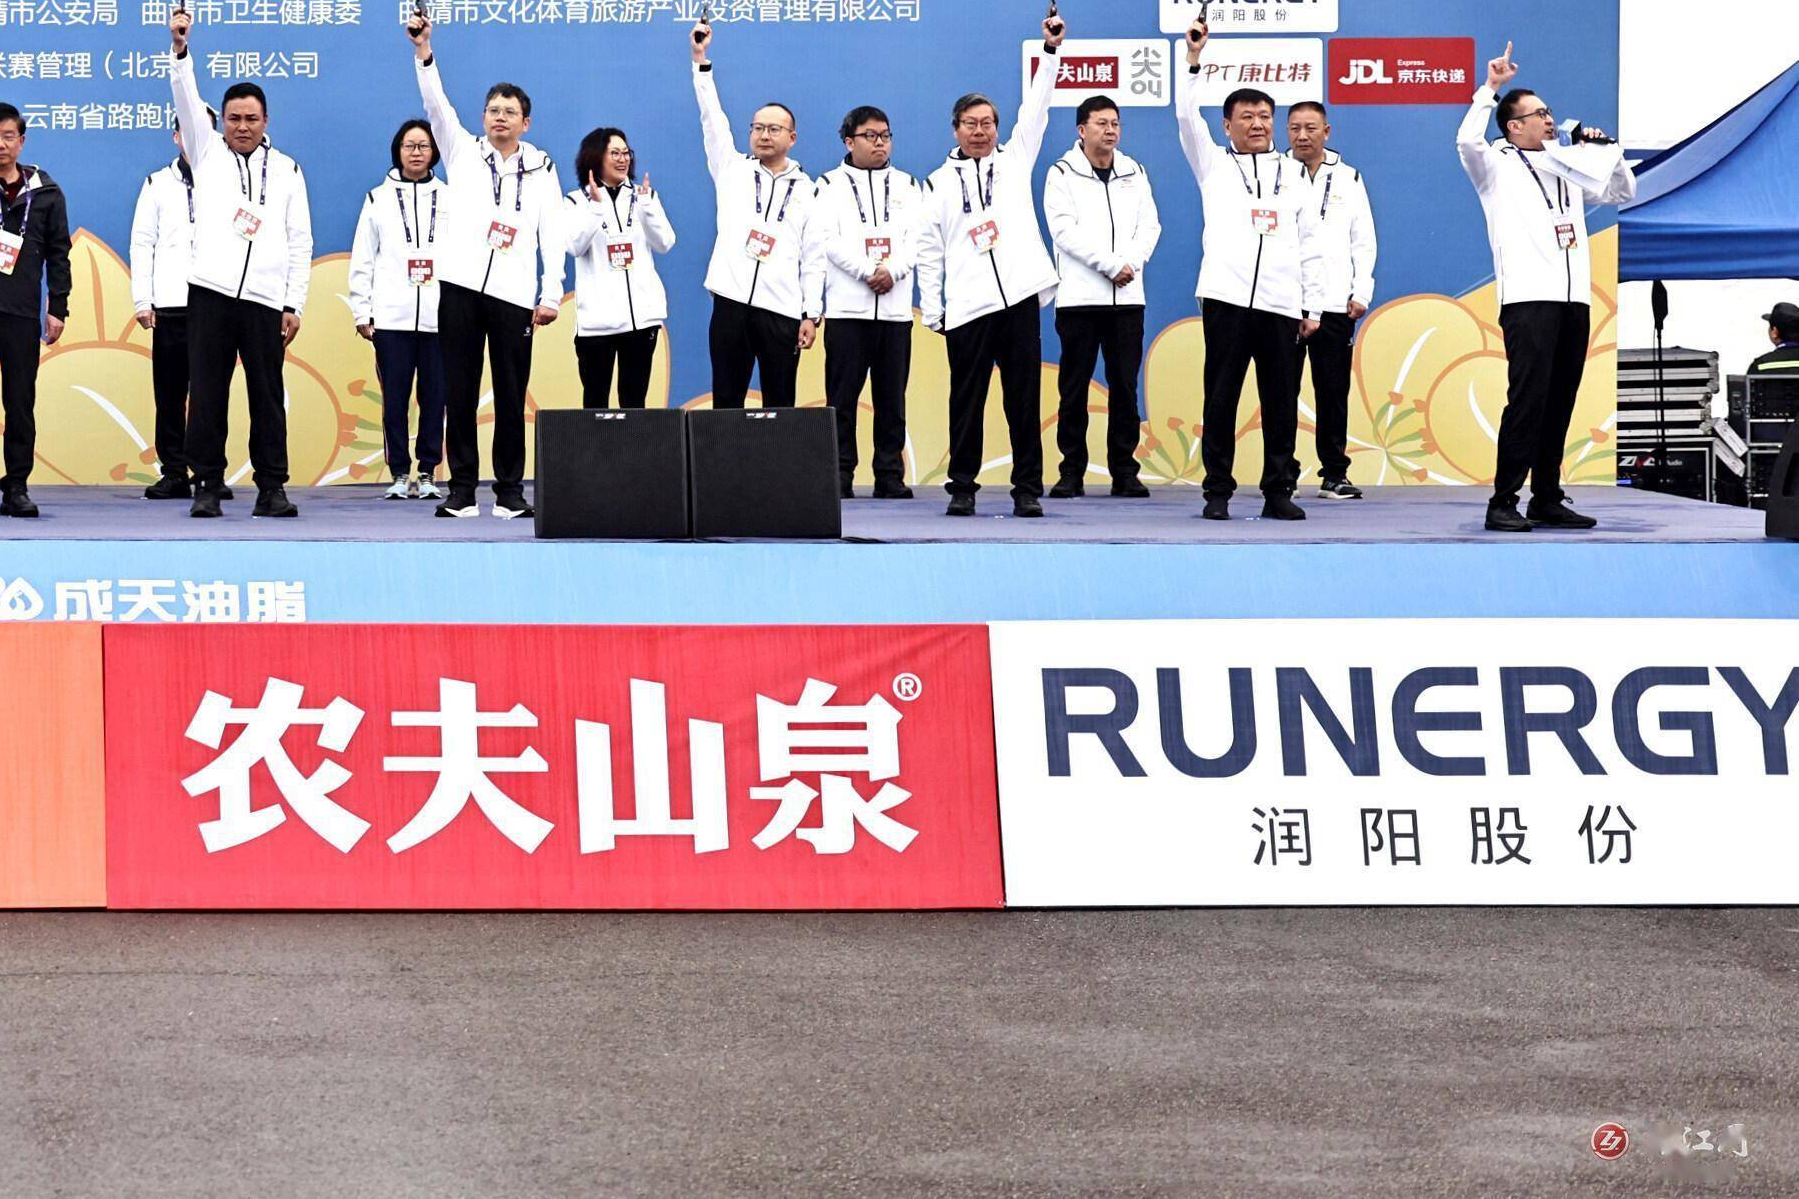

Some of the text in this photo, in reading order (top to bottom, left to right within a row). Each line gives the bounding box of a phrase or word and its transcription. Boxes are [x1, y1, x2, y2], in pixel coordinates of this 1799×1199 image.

[1211, 8, 1288, 22] 润阳股份
[1057, 62, 1114, 83] 夫山泉
[1203, 63, 1237, 83] PT
[1338, 59, 1394, 85] JDL
[1397, 69, 1466, 84] 京东快递
[22, 102, 220, 130] 云南省路跑协
[53, 578, 308, 623] 成天油脂
[181, 675, 920, 854] 农夫山泉
[1251, 804, 1640, 868] 润阳股份
